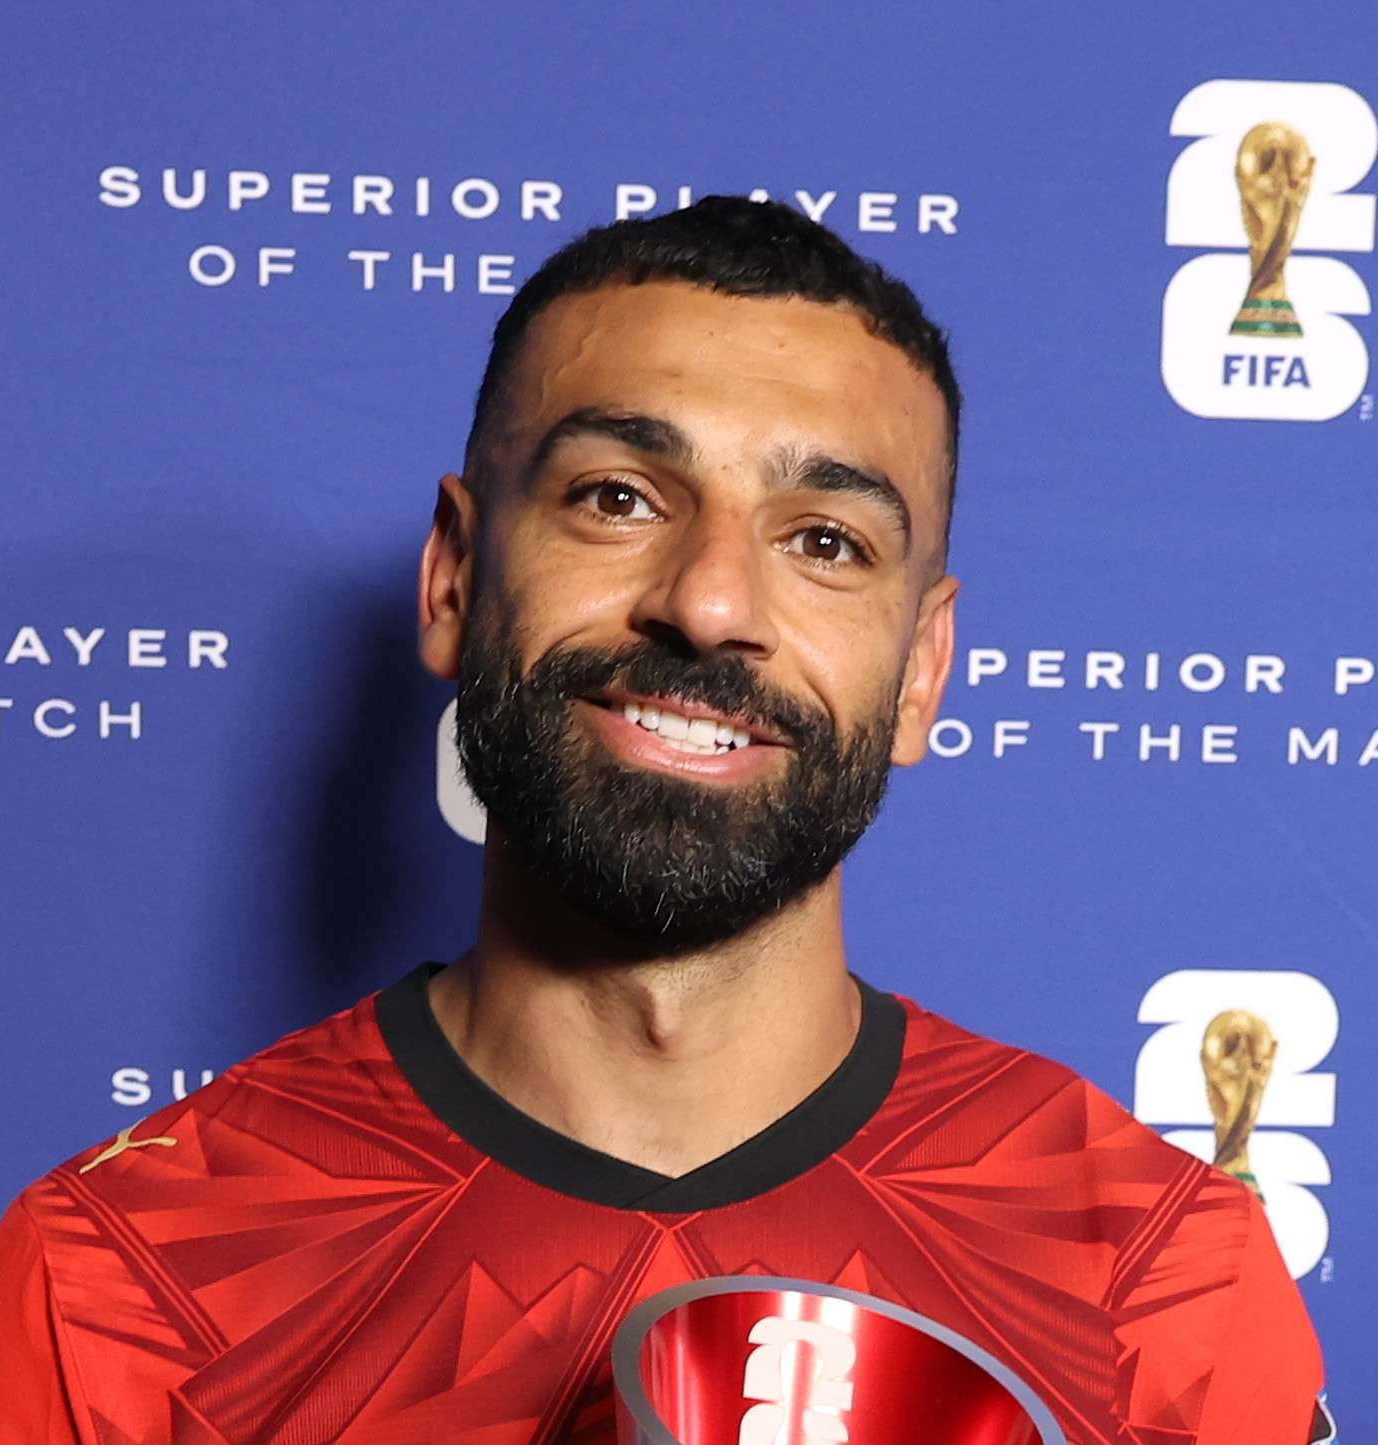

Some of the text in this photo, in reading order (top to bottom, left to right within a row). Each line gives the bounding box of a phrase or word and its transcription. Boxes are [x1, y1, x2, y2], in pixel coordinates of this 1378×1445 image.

[97, 164, 564, 223] SUPERIOR
[187, 243, 517, 297] OF THE
[1222, 354, 1311, 388] FIFA
[927, 717, 1032, 760] OF
[1077, 720, 1240, 765] THE
